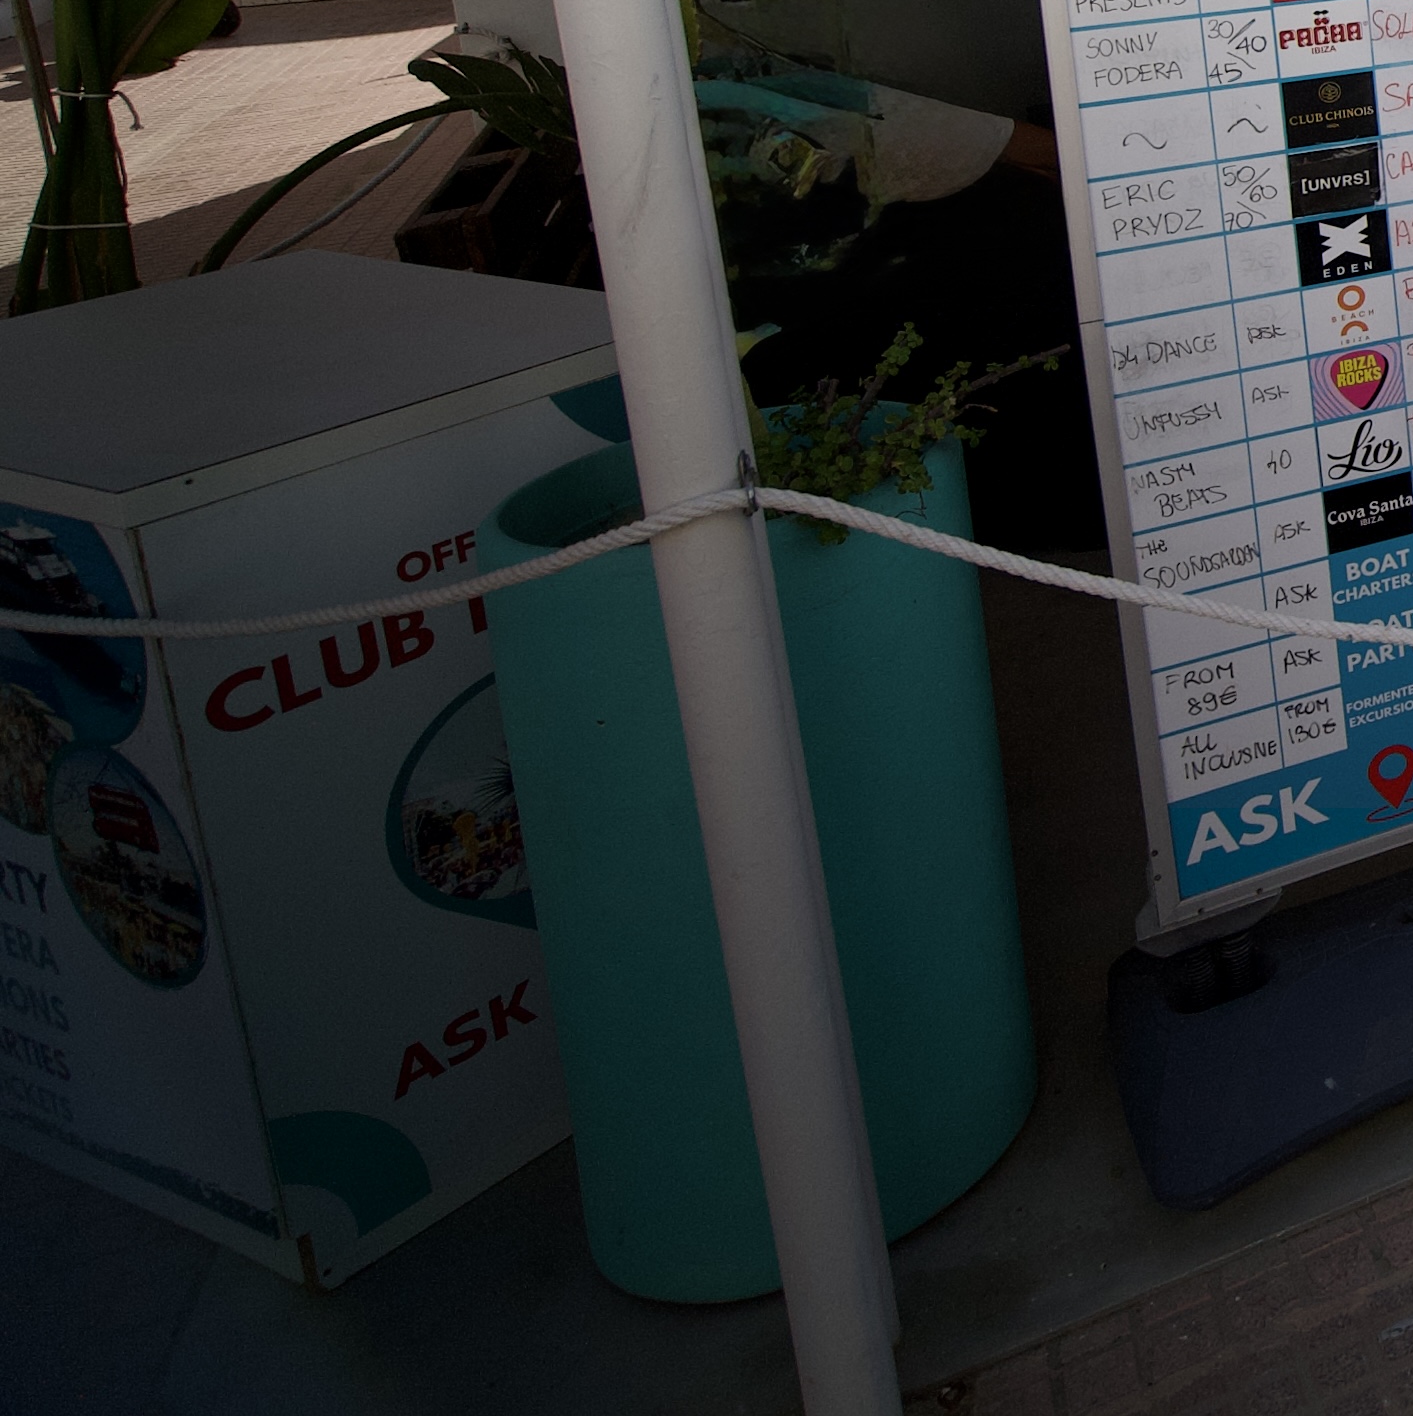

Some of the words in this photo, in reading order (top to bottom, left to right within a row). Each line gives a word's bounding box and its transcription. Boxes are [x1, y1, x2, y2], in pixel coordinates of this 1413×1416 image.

[1086, 32, 1157, 59] SONNY
[1311, 45, 1337, 55] IBIZA
[1094, 61, 1183, 88] FODERA
[1289, 112, 1325, 127] CLUB
[1325, 105, 1375, 122] CHINOIS
[1102, 180, 1175, 210] ERIC
[1301, 170, 1371, 195] [UNVRS]
[1113, 209, 1204, 241] PRYDZ
[1322, 261, 1374, 278] EDEN
[1331, 309, 1375, 323] BEACH
[1146, 333, 1217, 364] DANCE
[1337, 367, 1382, 387] ROCKS
[1339, 355, 1377, 373] IBIZA
[1252, 385, 1289, 404] ASK
[1130, 462, 1195, 494] NASTY
[1154, 486, 1227, 518] BEATS
[1327, 506, 1366, 525] Cova
[1368, 494, 1413, 516] Santa
[1274, 520, 1311, 543] ASK
[1360, 515, 1384, 527] IBIZA
[1346, 549, 1411, 582] BOAT
[1275, 584, 1318, 609] ASK
[205, 612, 435, 733] CLUB
[1284, 649, 1322, 674] ASK
[1165, 662, 1234, 694] FROM
[1188, 686, 1237, 716] 89€
[1285, 698, 1330, 719] FROM
[1187, 776, 1329, 867] ASK
[394, 980, 538, 1102] ASK
